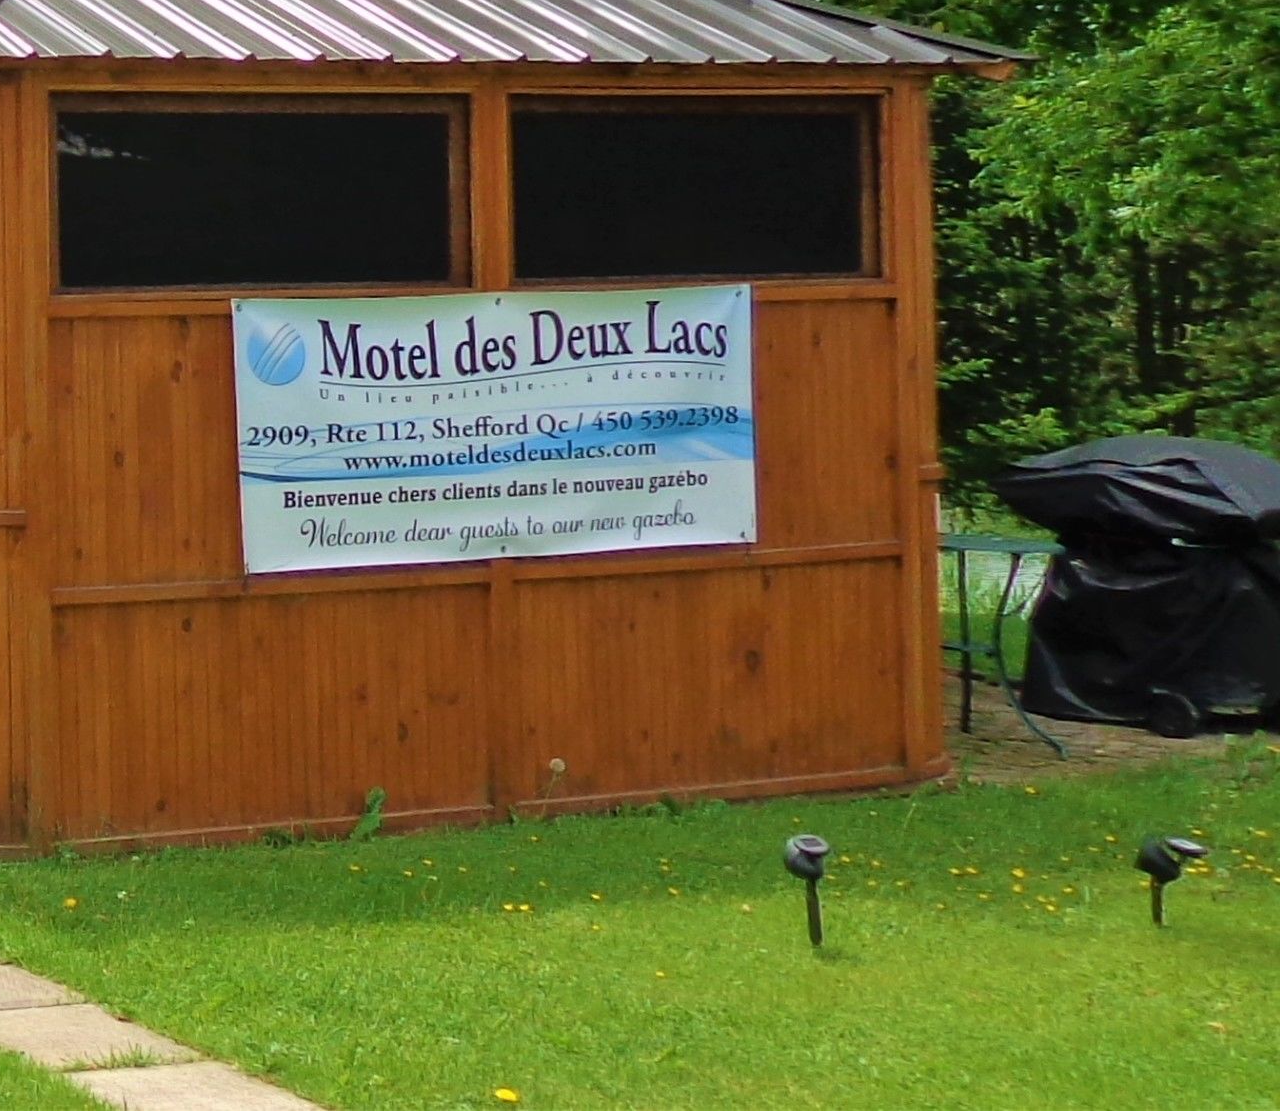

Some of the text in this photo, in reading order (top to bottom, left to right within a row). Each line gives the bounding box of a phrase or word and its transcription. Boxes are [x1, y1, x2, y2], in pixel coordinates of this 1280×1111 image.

[317, 300, 728, 380] Motel des Deux Lacs
[319, 389, 345, 401] Un
[365, 390, 413, 403] lieu
[612, 369, 726, 381] découvrir
[246, 405, 739, 447] 2909, Rte 112, Shefford Qc / 450 539.2398
[343, 440, 657, 470] www.moteldesdeuxlacs.com
[283, 469, 708, 508] Bienvenue chers clients dans le nouveau gazébo
[300, 499, 697, 552] Welcome dear guests to our new gazebo
